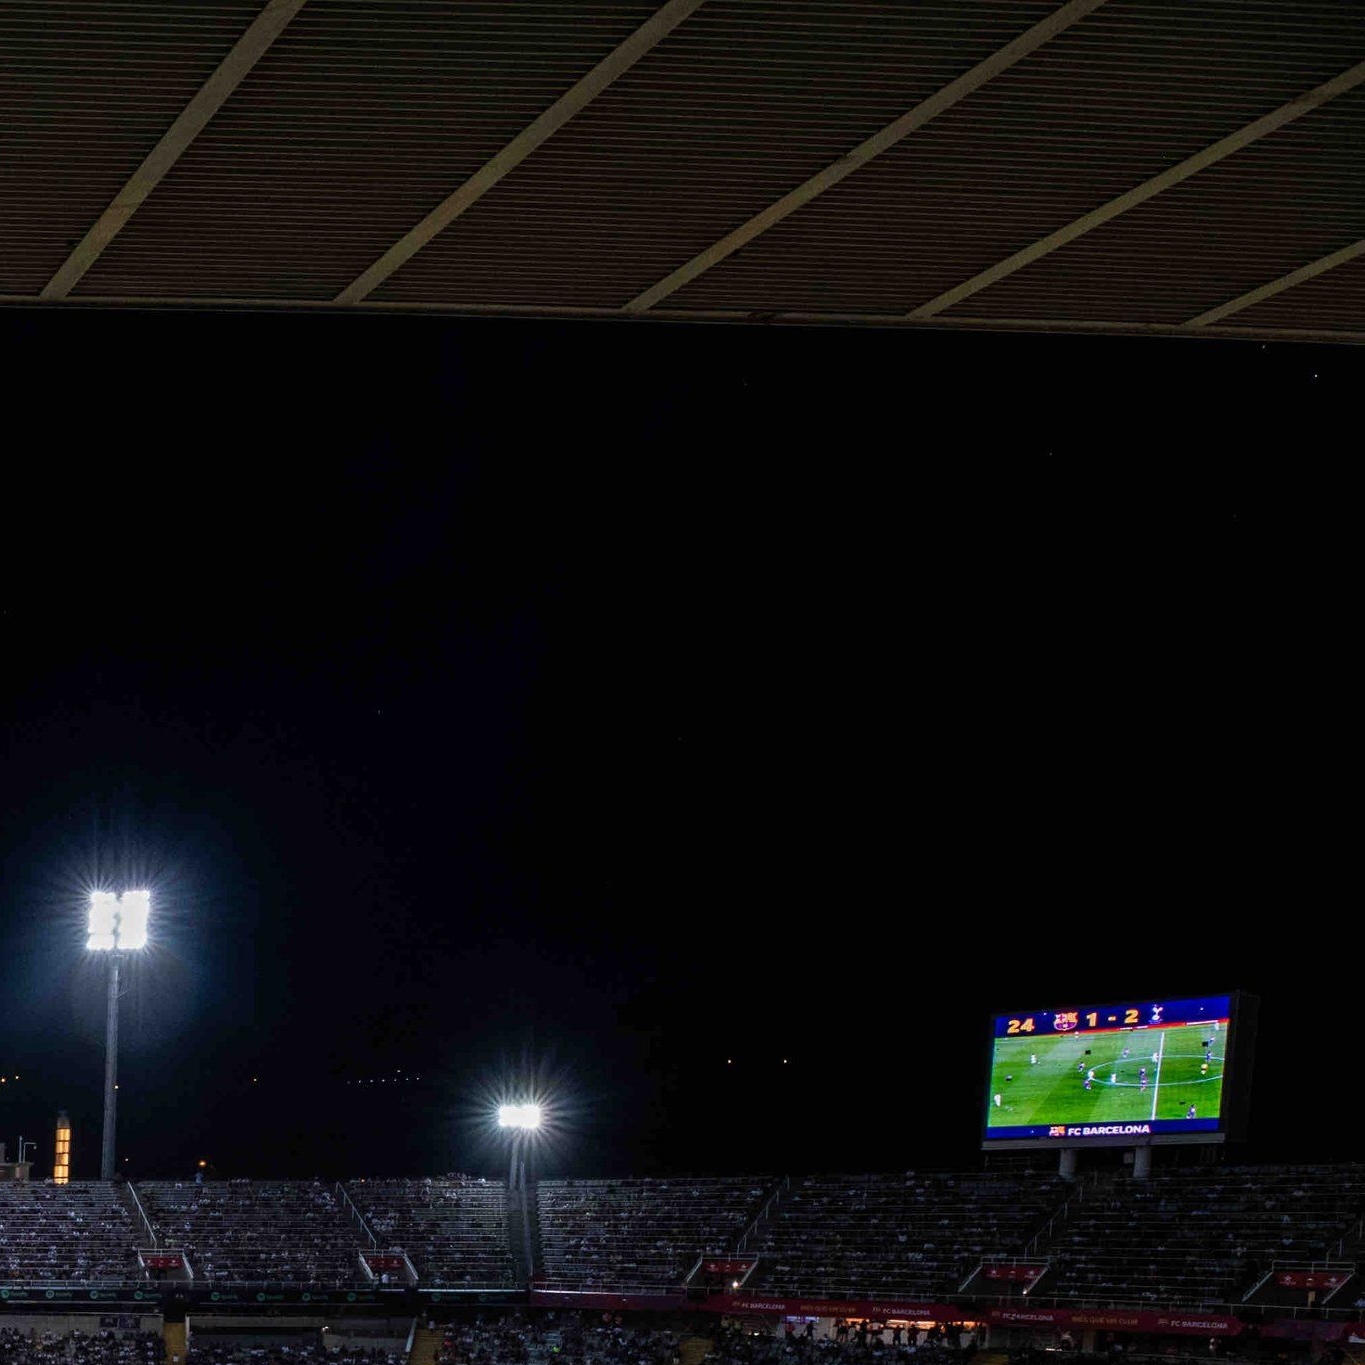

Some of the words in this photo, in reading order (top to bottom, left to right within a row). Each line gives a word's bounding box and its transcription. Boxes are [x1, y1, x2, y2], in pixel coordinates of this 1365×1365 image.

[1086, 1012, 1097, 1026] 1
[1124, 1009, 1139, 1023] 2
[1007, 1018, 1035, 1033] 24
[1067, 1127, 1081, 1136] FC
[1083, 1124, 1150, 1135] BARCELONA
